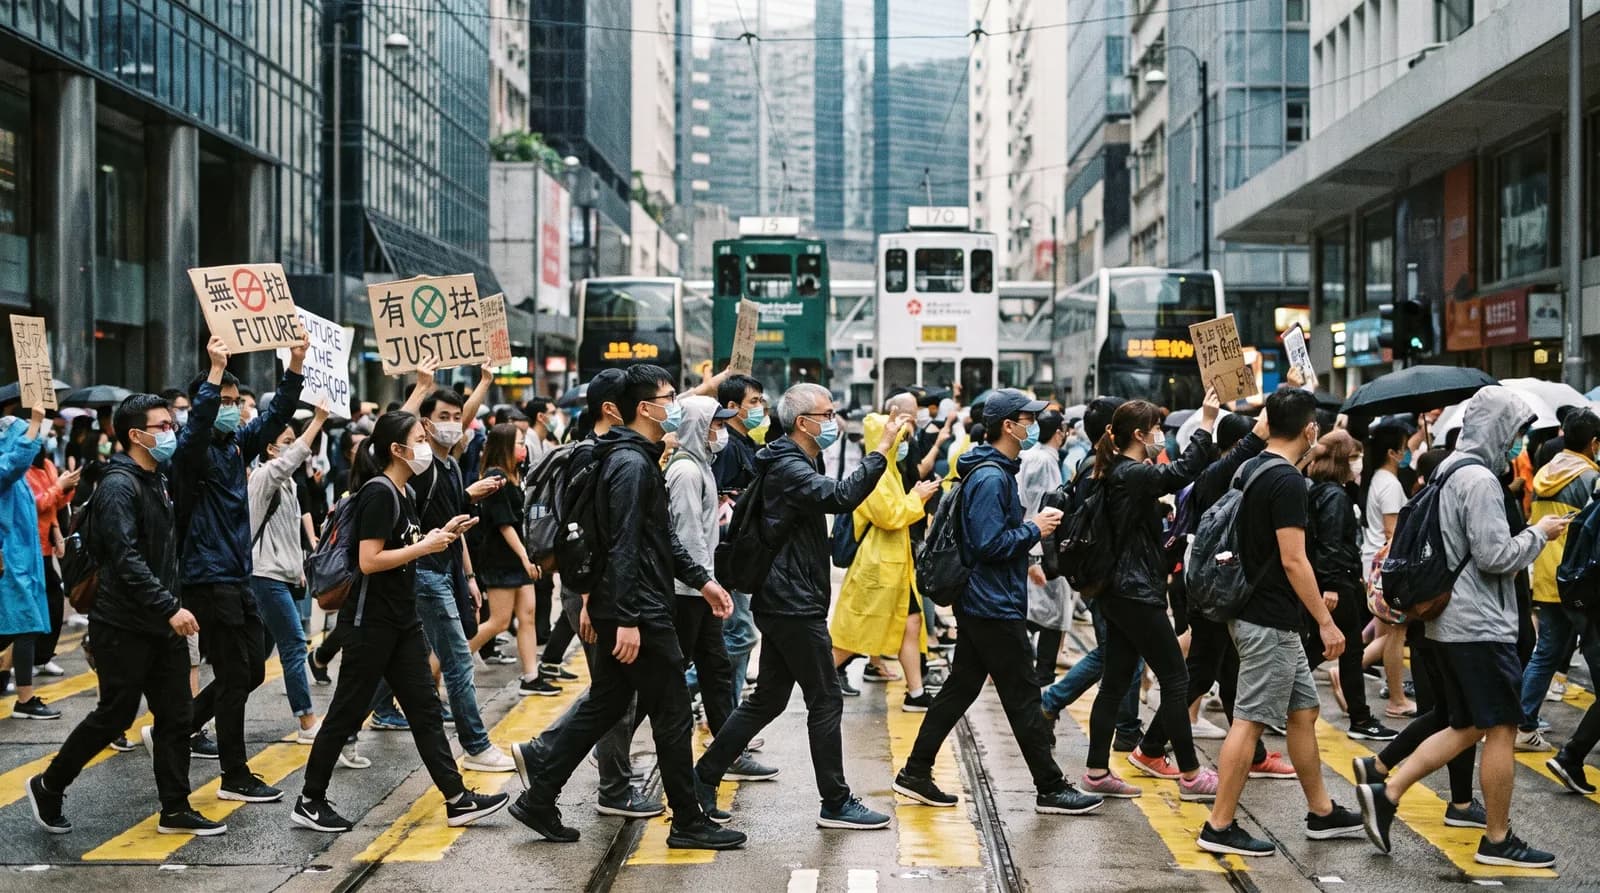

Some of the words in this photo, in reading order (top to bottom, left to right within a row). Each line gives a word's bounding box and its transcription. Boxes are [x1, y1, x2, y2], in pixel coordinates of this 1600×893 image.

[379, 291, 405, 328] 有
[232, 314, 304, 346] FUTURE
[386, 328, 485, 366] JUSTICE
[311, 345, 333, 369] THE
